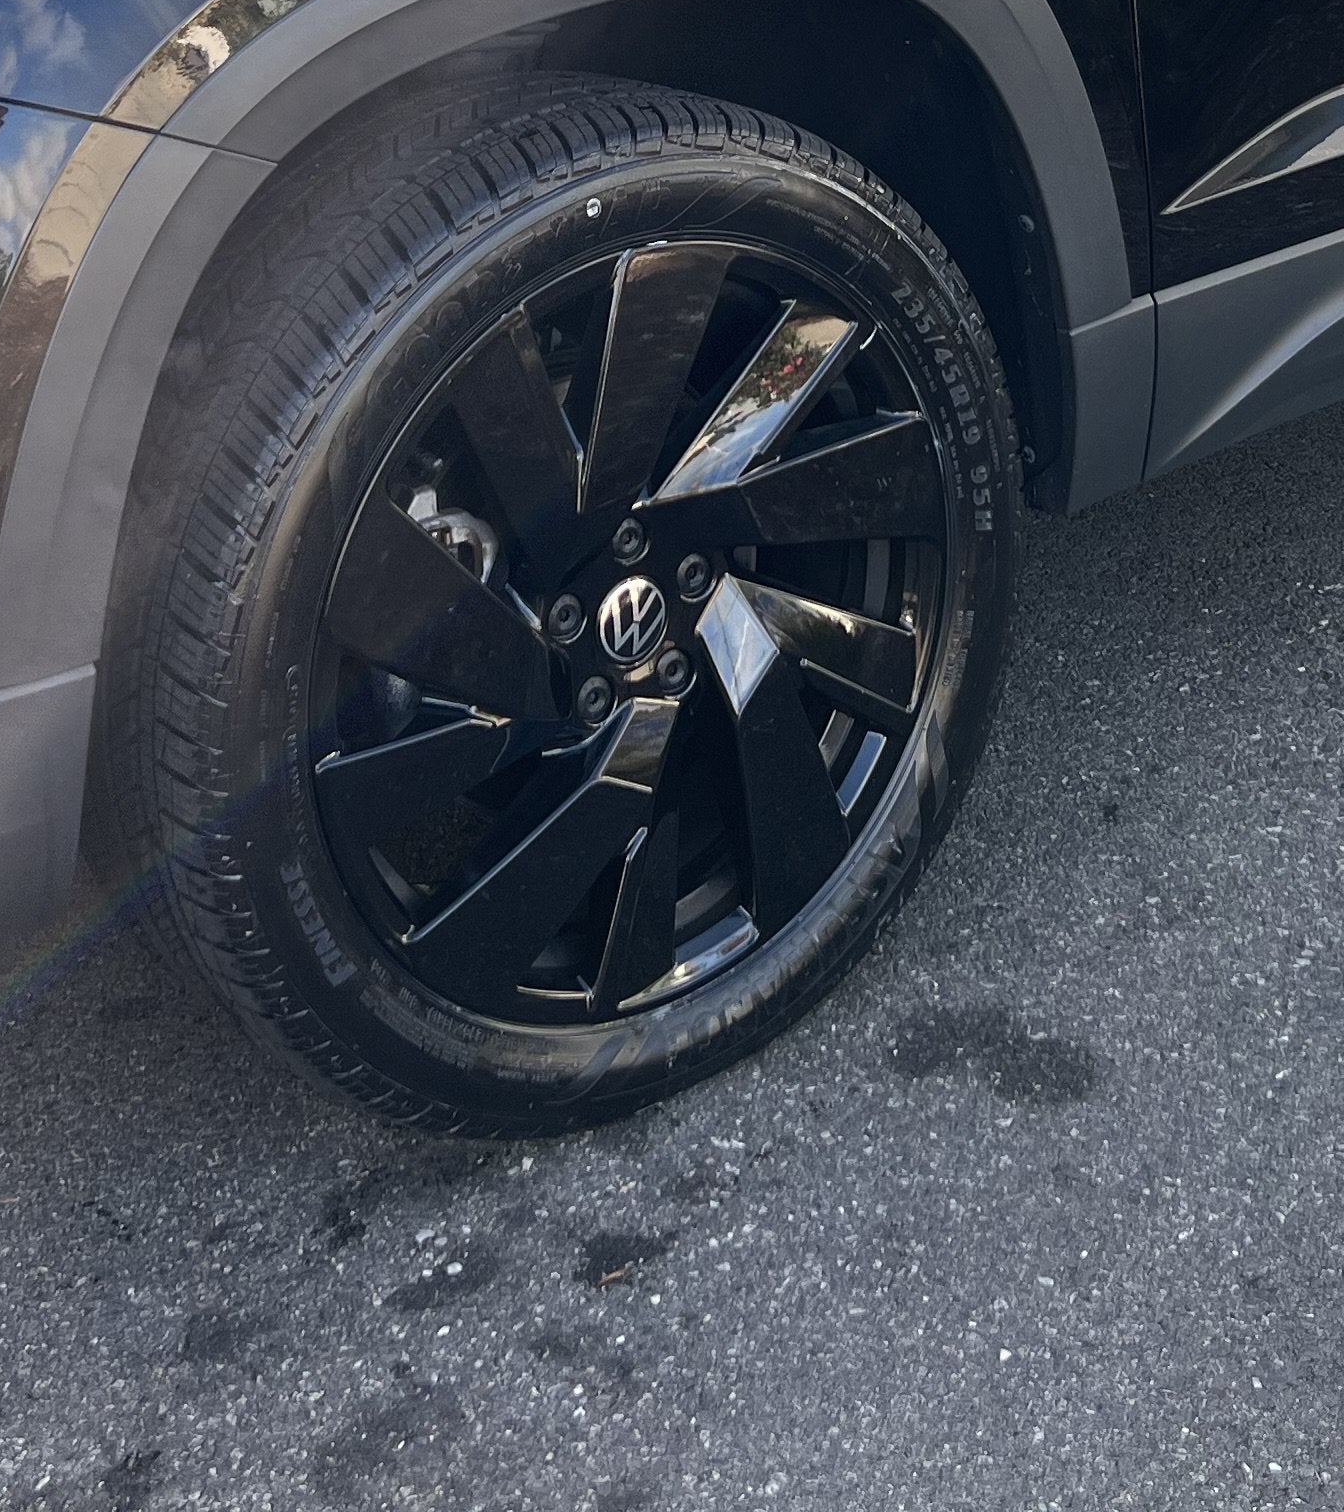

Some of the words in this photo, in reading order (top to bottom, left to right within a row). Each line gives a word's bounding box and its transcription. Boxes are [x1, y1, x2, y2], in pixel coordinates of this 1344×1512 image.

[890, 277, 982, 450] 235/45R19
[968, 462, 994, 535] 95H
[278, 856, 359, 988] FINESSE
